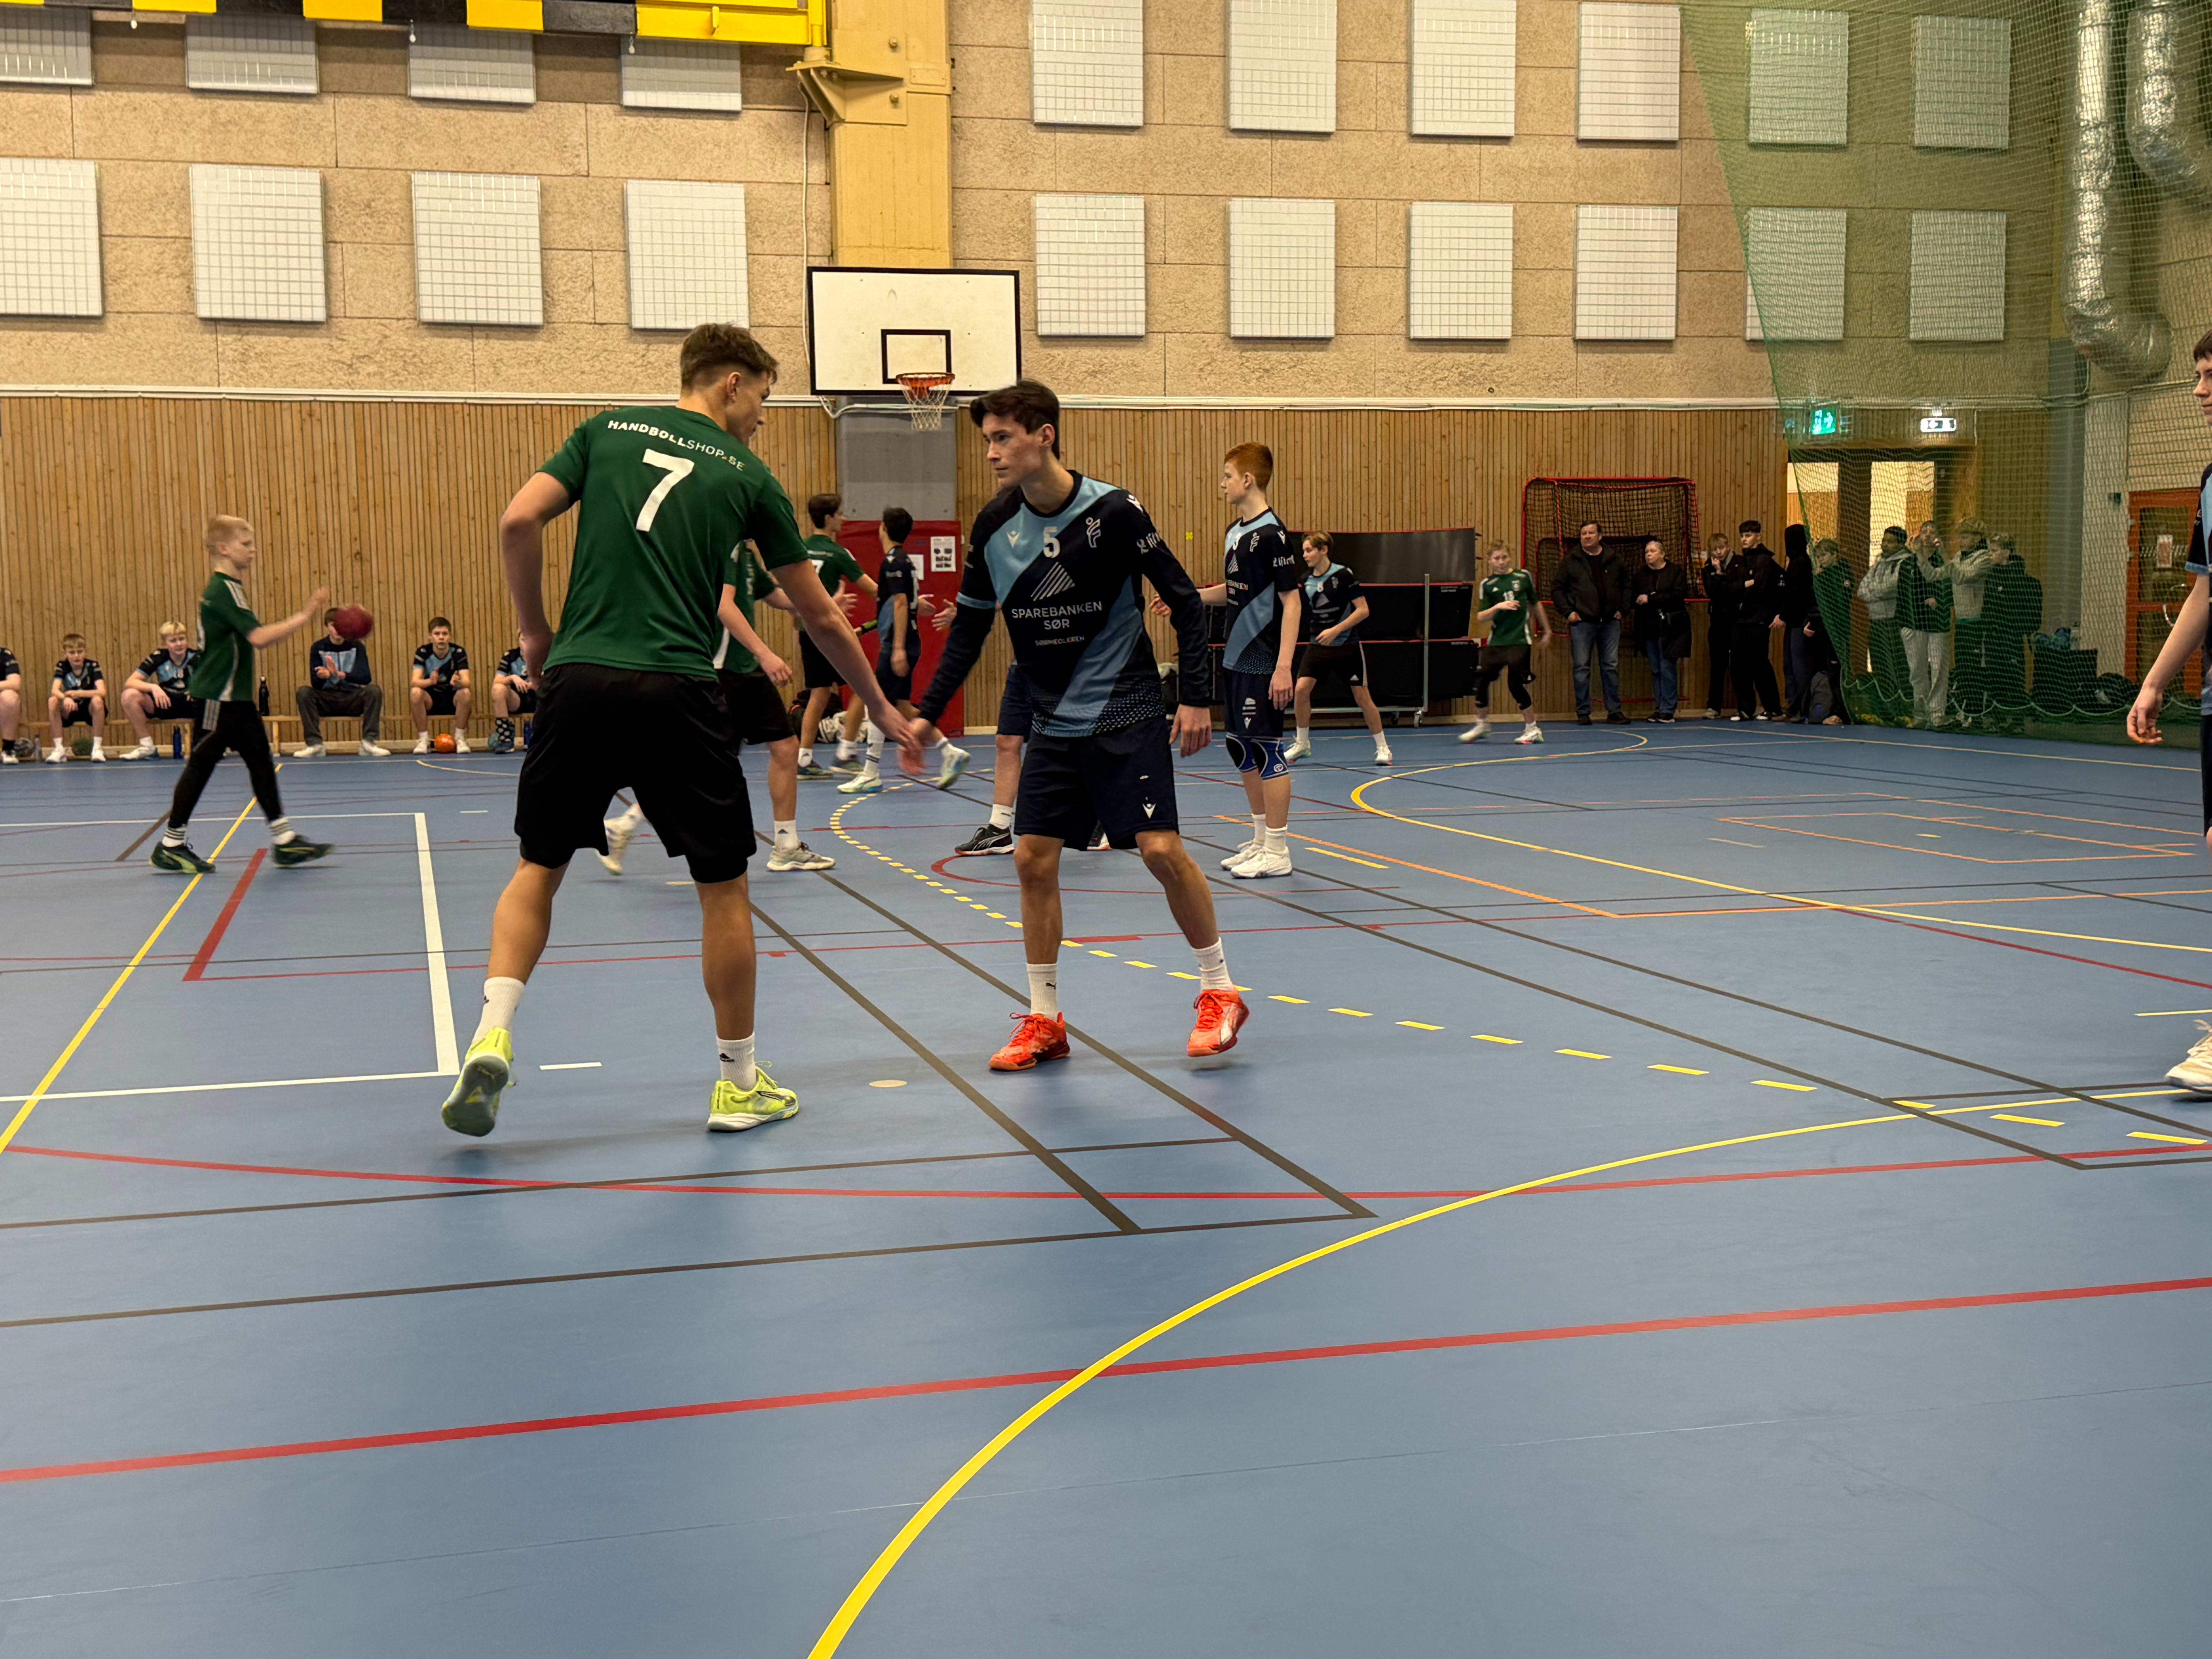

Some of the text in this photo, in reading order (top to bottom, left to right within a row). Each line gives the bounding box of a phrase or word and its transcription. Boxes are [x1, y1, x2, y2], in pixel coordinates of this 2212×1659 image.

[608, 420, 745, 471] HANDBOLLSHOP.SE
[636, 448, 695, 532] 7
[1043, 526, 1060, 558] 5
[1012, 601, 1102, 618] SPAREBANKEN
[1044, 619, 1070, 630] SØR
